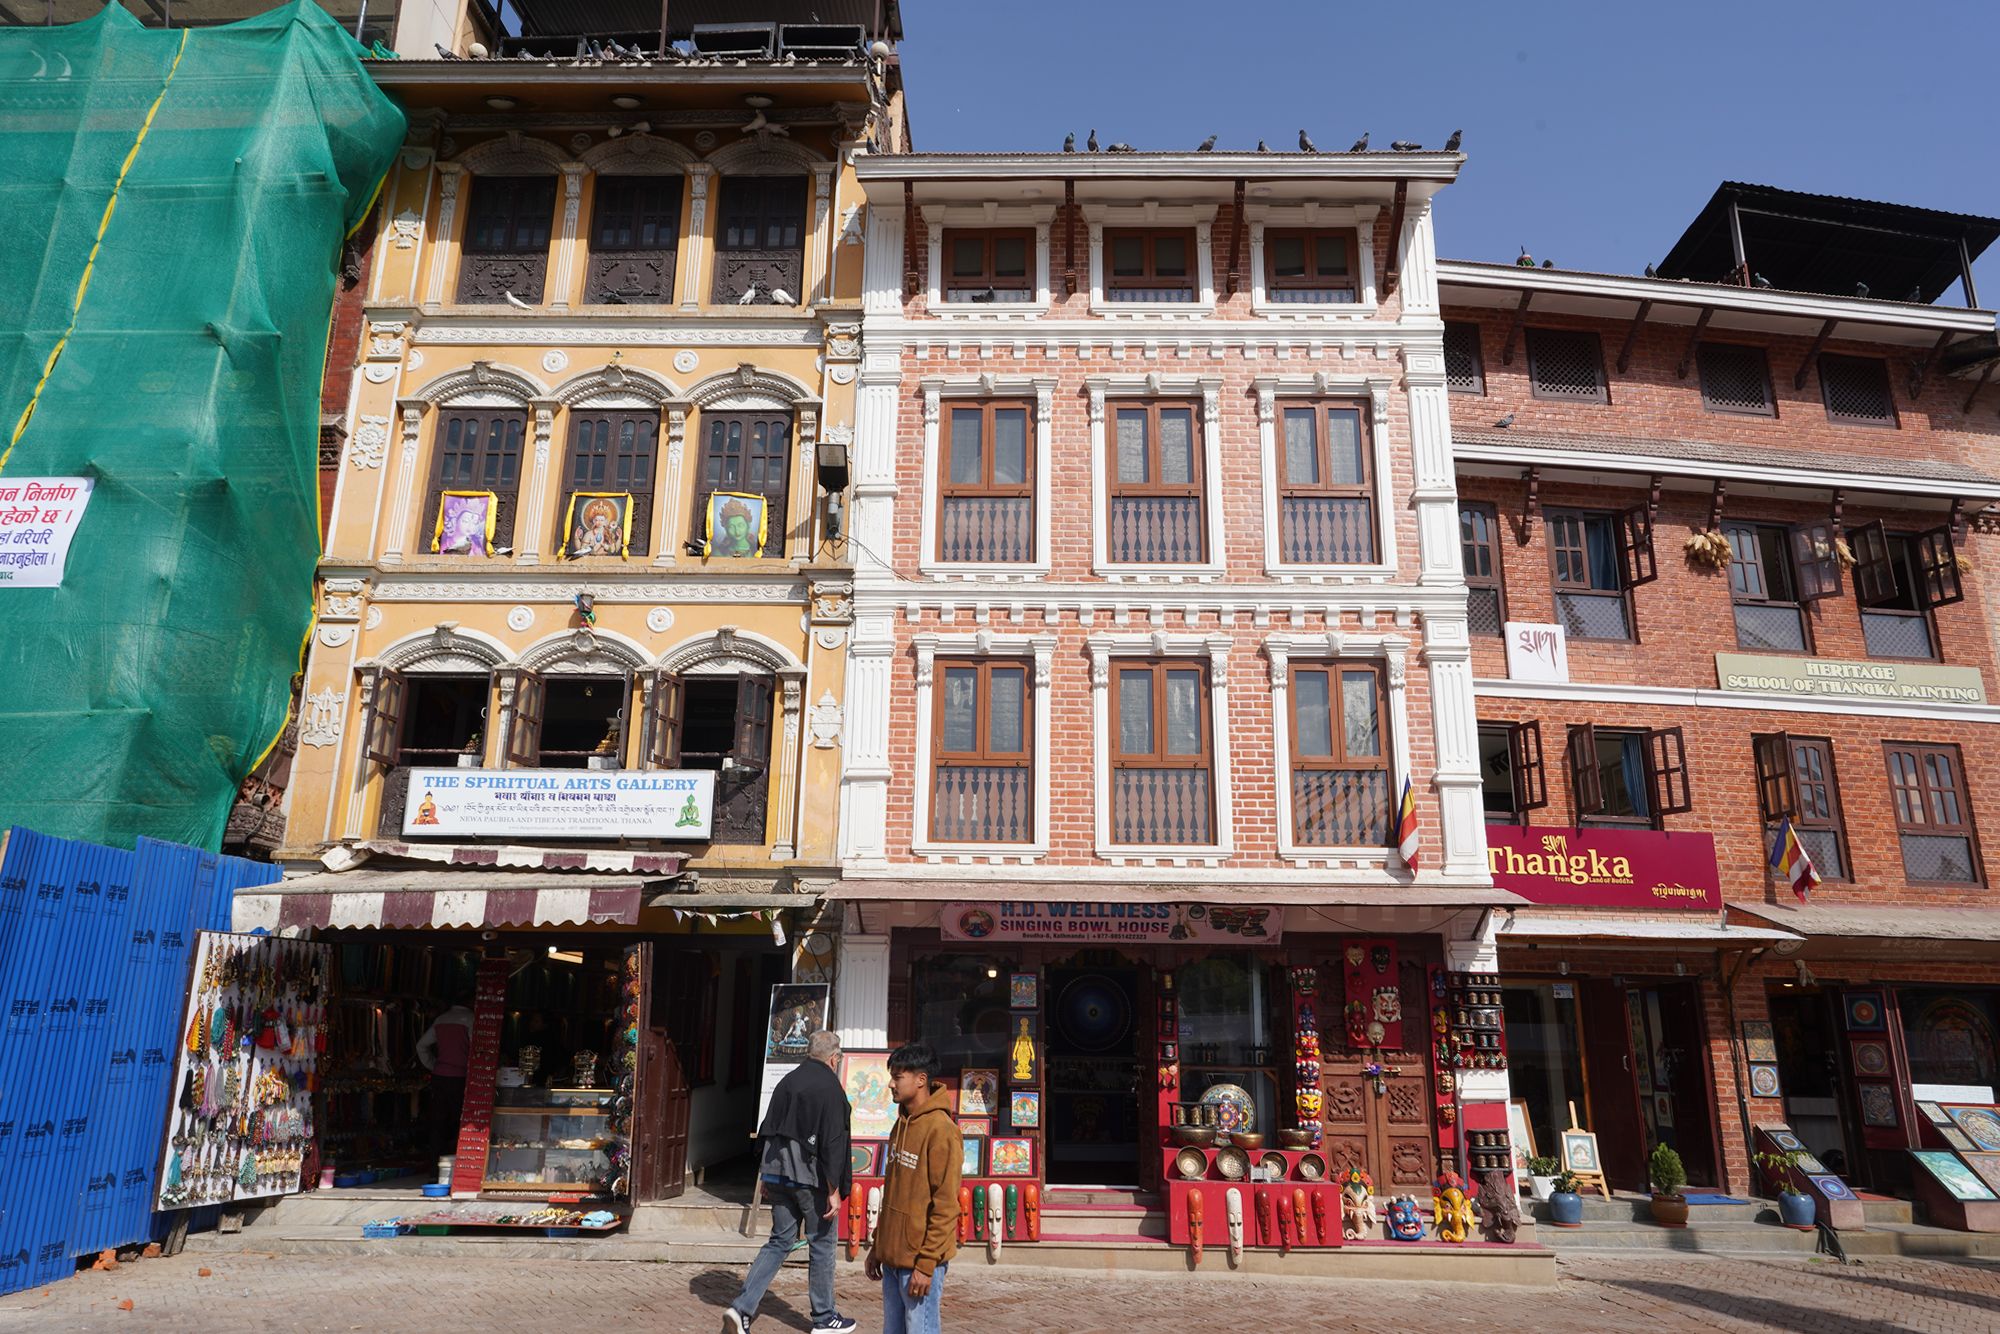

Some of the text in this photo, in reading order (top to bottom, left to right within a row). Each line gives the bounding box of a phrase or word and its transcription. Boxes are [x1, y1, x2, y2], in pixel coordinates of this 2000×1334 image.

[41, 509, 62, 524] छ
[1804, 662, 1896, 681] HERITAGE
[1727, 674, 1981, 701] SCHOOL OF THANGKA PAINTING
[423, 776, 698, 791] THE SPIRITUAL ARTS GALLERY
[1487, 846, 1633, 885] Thangka
[1001, 902, 1171, 919] H.D. WELLNESS
[1000, 920, 1169, 933] SINGING BOWL HOUSE
